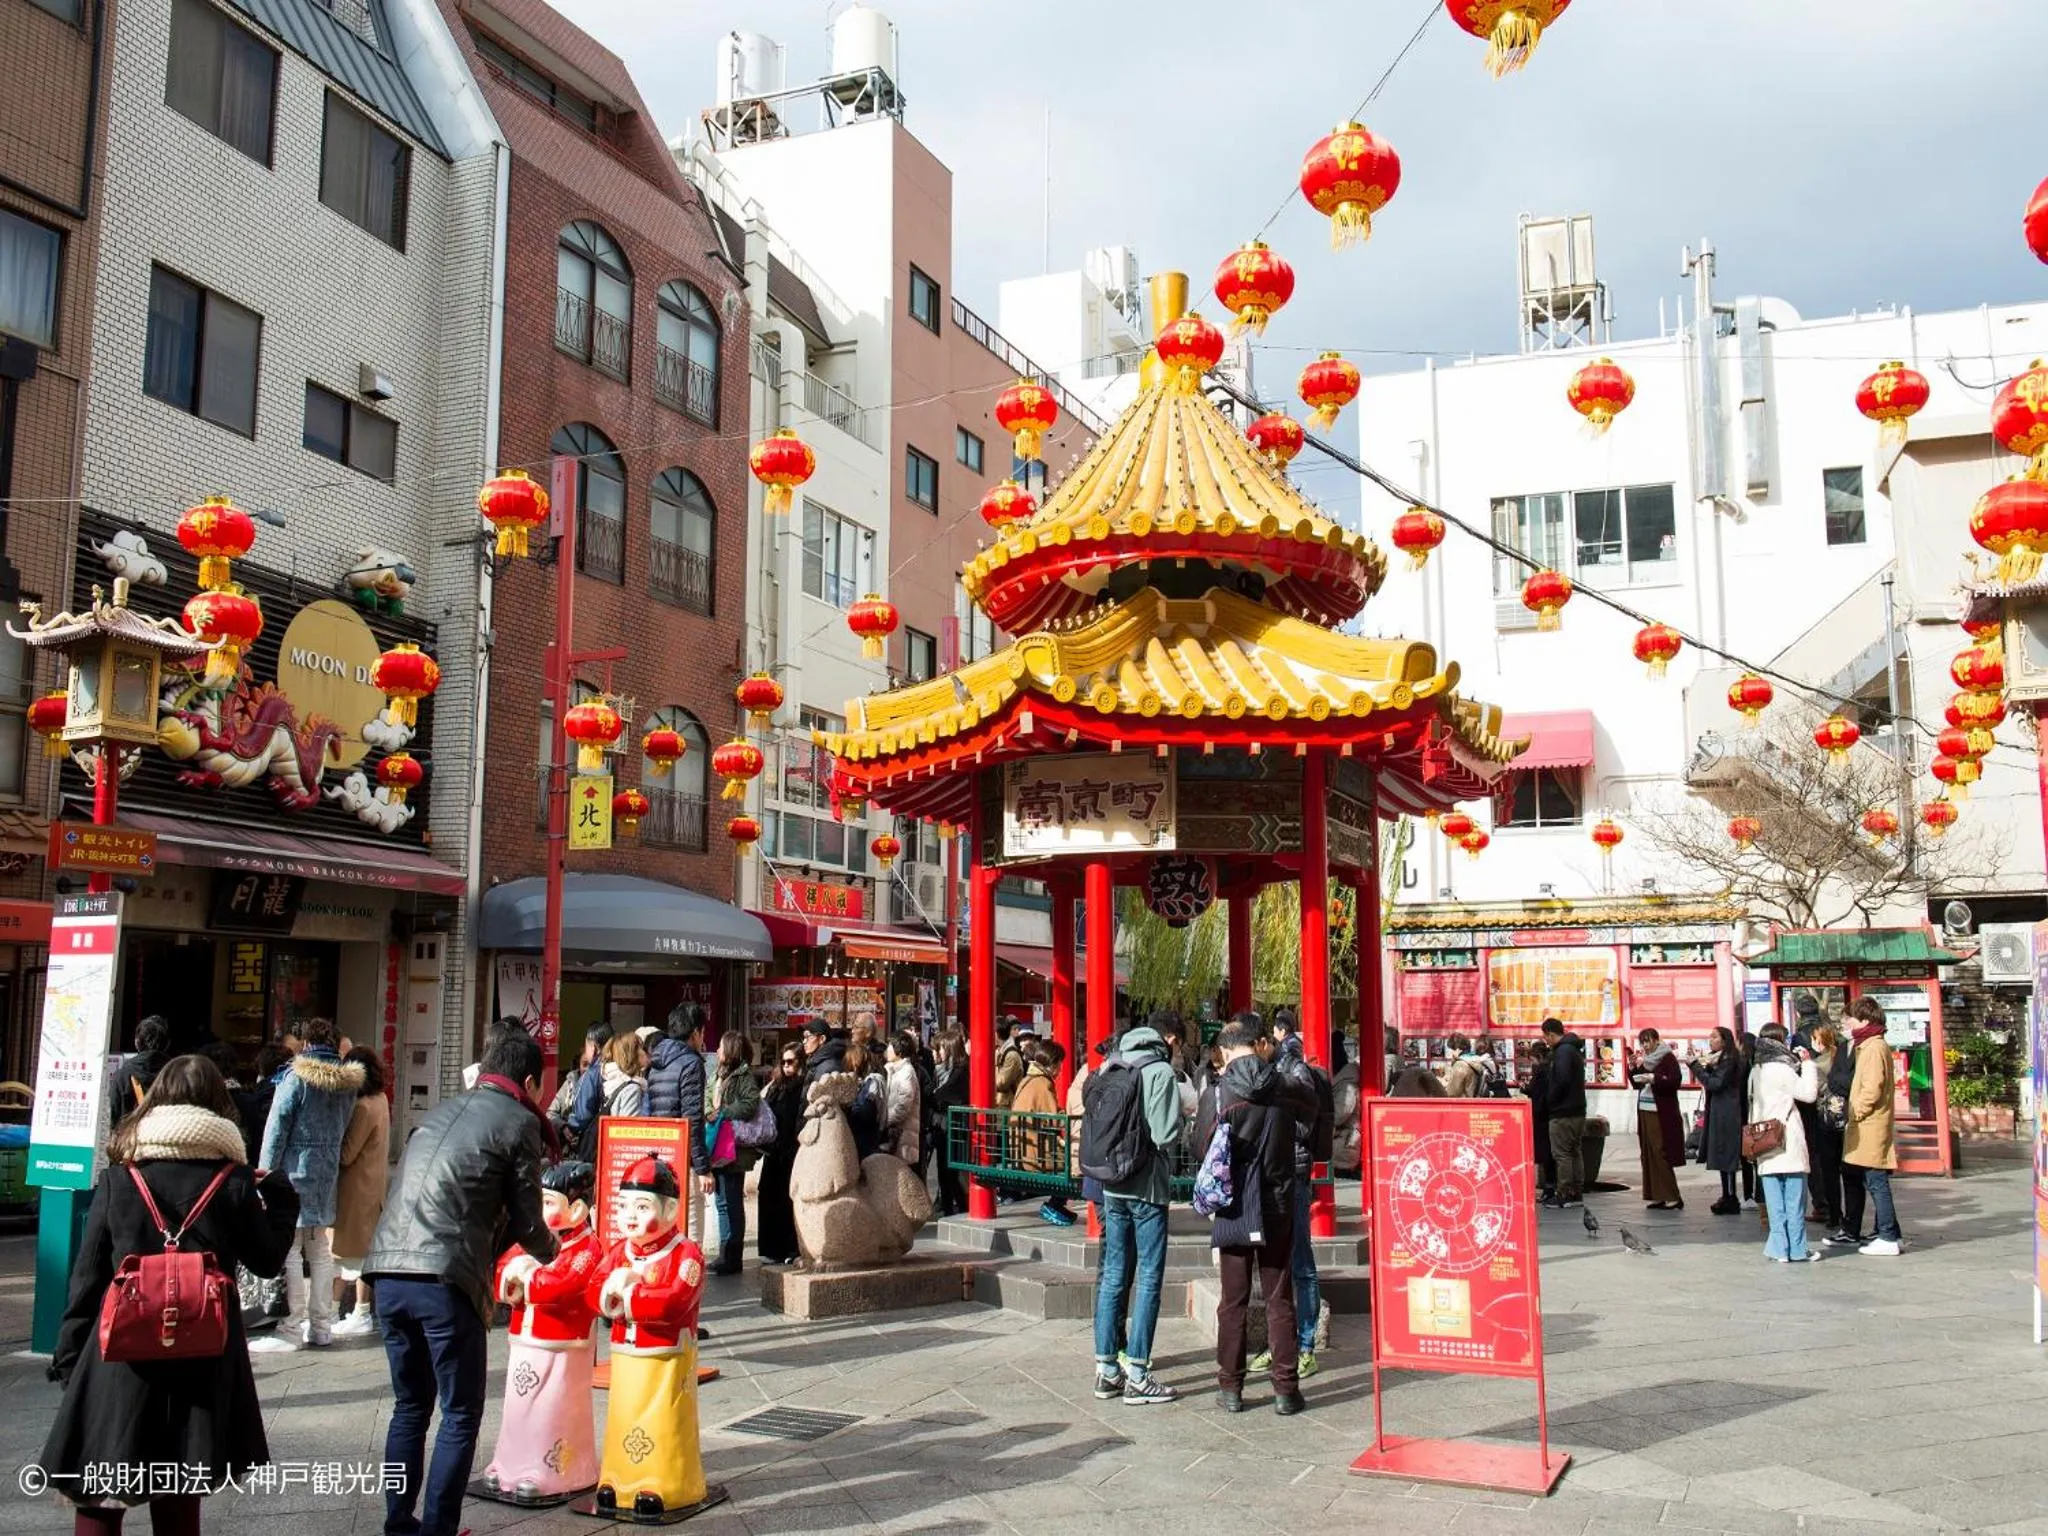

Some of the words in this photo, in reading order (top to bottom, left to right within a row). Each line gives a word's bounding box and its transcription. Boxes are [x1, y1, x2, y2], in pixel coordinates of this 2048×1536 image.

[290, 646, 346, 677] MOON
[1014, 777, 1166, 825] 南京町
[578, 803, 602, 828] 北
[83, 833, 149, 850] 観光トイレ
[265, 860, 305, 874] MOON
[312, 865, 364, 881] DRAGON
